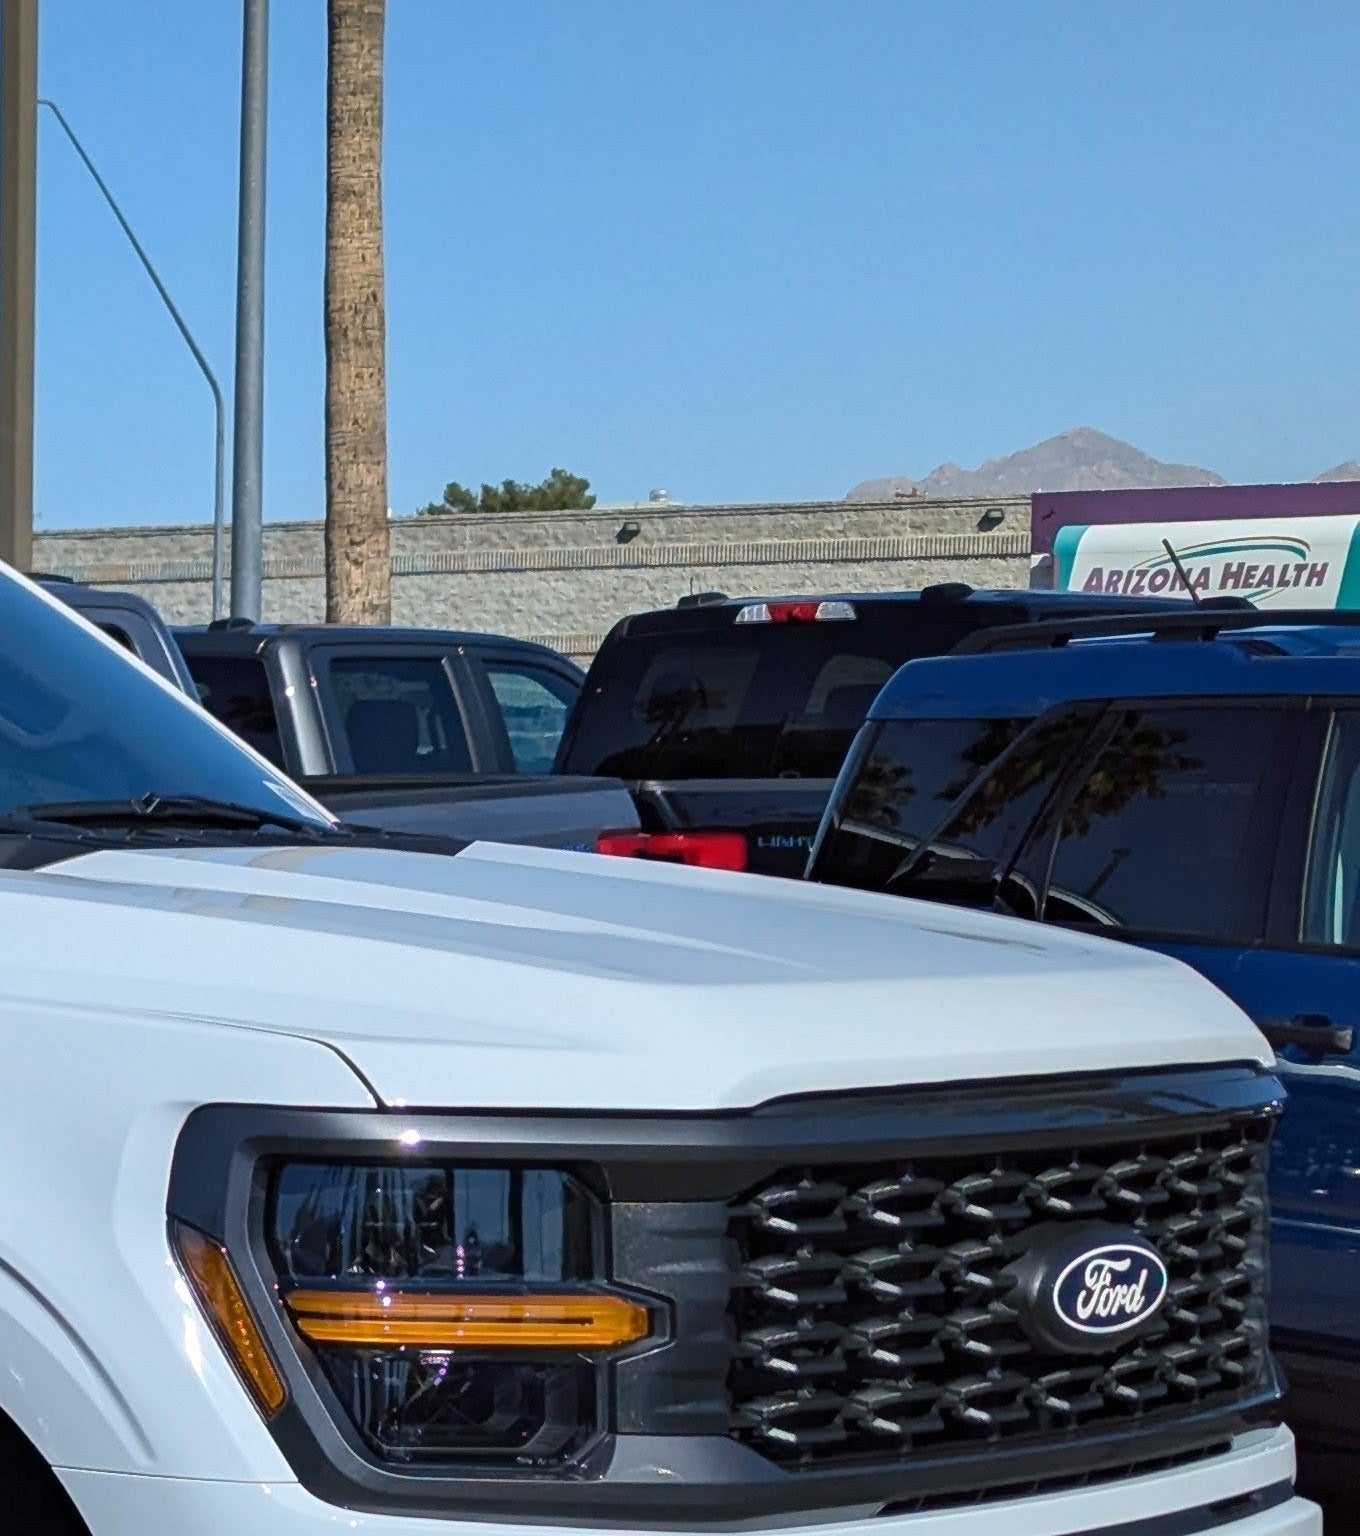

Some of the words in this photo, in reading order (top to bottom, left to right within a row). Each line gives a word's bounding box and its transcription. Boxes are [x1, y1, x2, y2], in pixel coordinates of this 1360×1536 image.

[1083, 566, 1210, 595] ARIZONA
[1218, 561, 1329, 590] HEALTH
[1076, 1257, 1148, 1320] Ford
